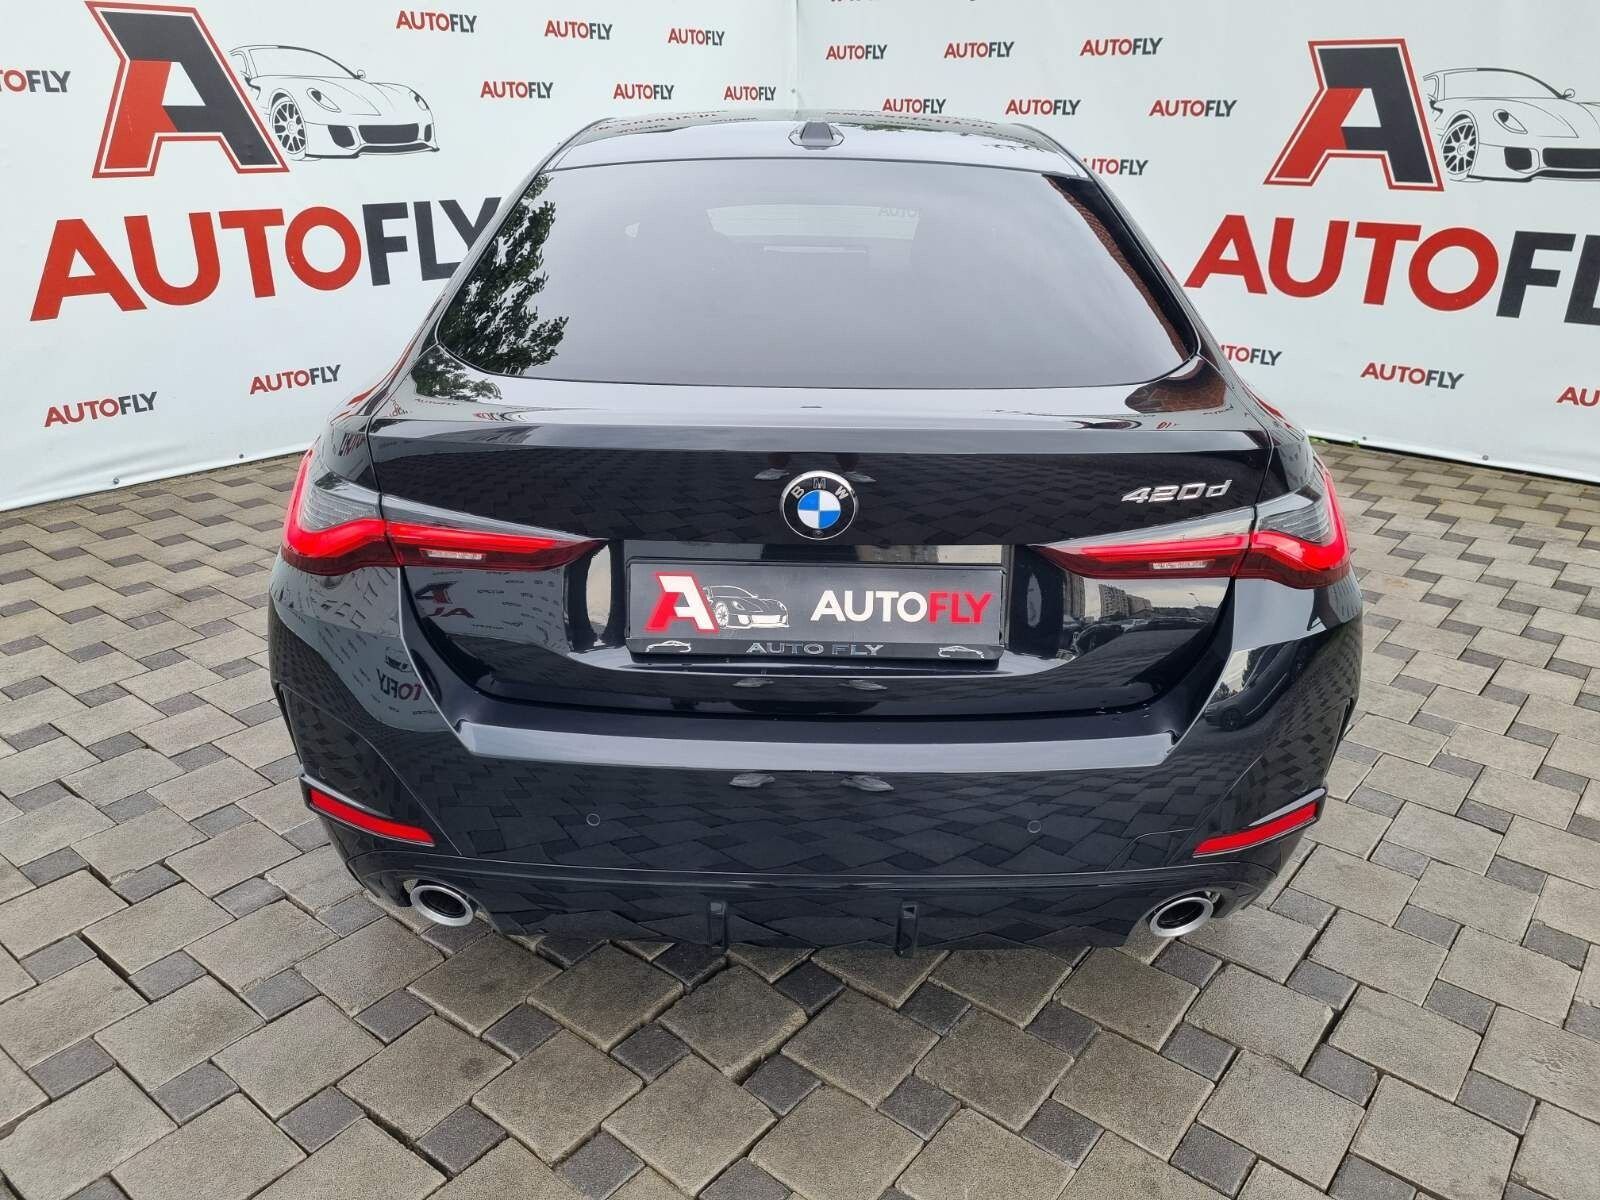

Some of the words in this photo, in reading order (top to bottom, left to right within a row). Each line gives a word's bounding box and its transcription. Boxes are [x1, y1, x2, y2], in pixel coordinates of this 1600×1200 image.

[395, 10, 478, 34] AUTOFLY
[544, 19, 613, 41] AUTOFLY
[667, 27, 726, 47] AUTOFLY
[1079, 37, 1164, 57] AUTOFLY
[825, 44, 888, 61] AUTOFLY
[943, 41, 1015, 59] AUTOFLY
[0, 69, 71, 93] OFLY
[479, 80, 554, 99] AUTOFLY
[612, 83, 675, 101] AUTOFLY
[723, 85, 777, 102] AUTOFLY
[882, 98, 947, 114] AUTOFLY
[1004, 99, 1082, 116] AUTOFLY
[1148, 99, 1237, 118] AUTOFLY
[30, 196, 502, 321] AUTOFLY
[1221, 344, 1283, 367] TOFLY
[249, 364, 341, 395] AUTOFLY
[1359, 362, 1465, 390] AUTOFLY
[44, 391, 158, 427] AUTOFLY
[791, 477, 849, 500] BMW
[1120, 479, 1233, 504] 420d
[810, 589, 993, 625] AUTOFLY
[746, 641, 824, 656] AUTO
[831, 642, 884, 656] FLY
